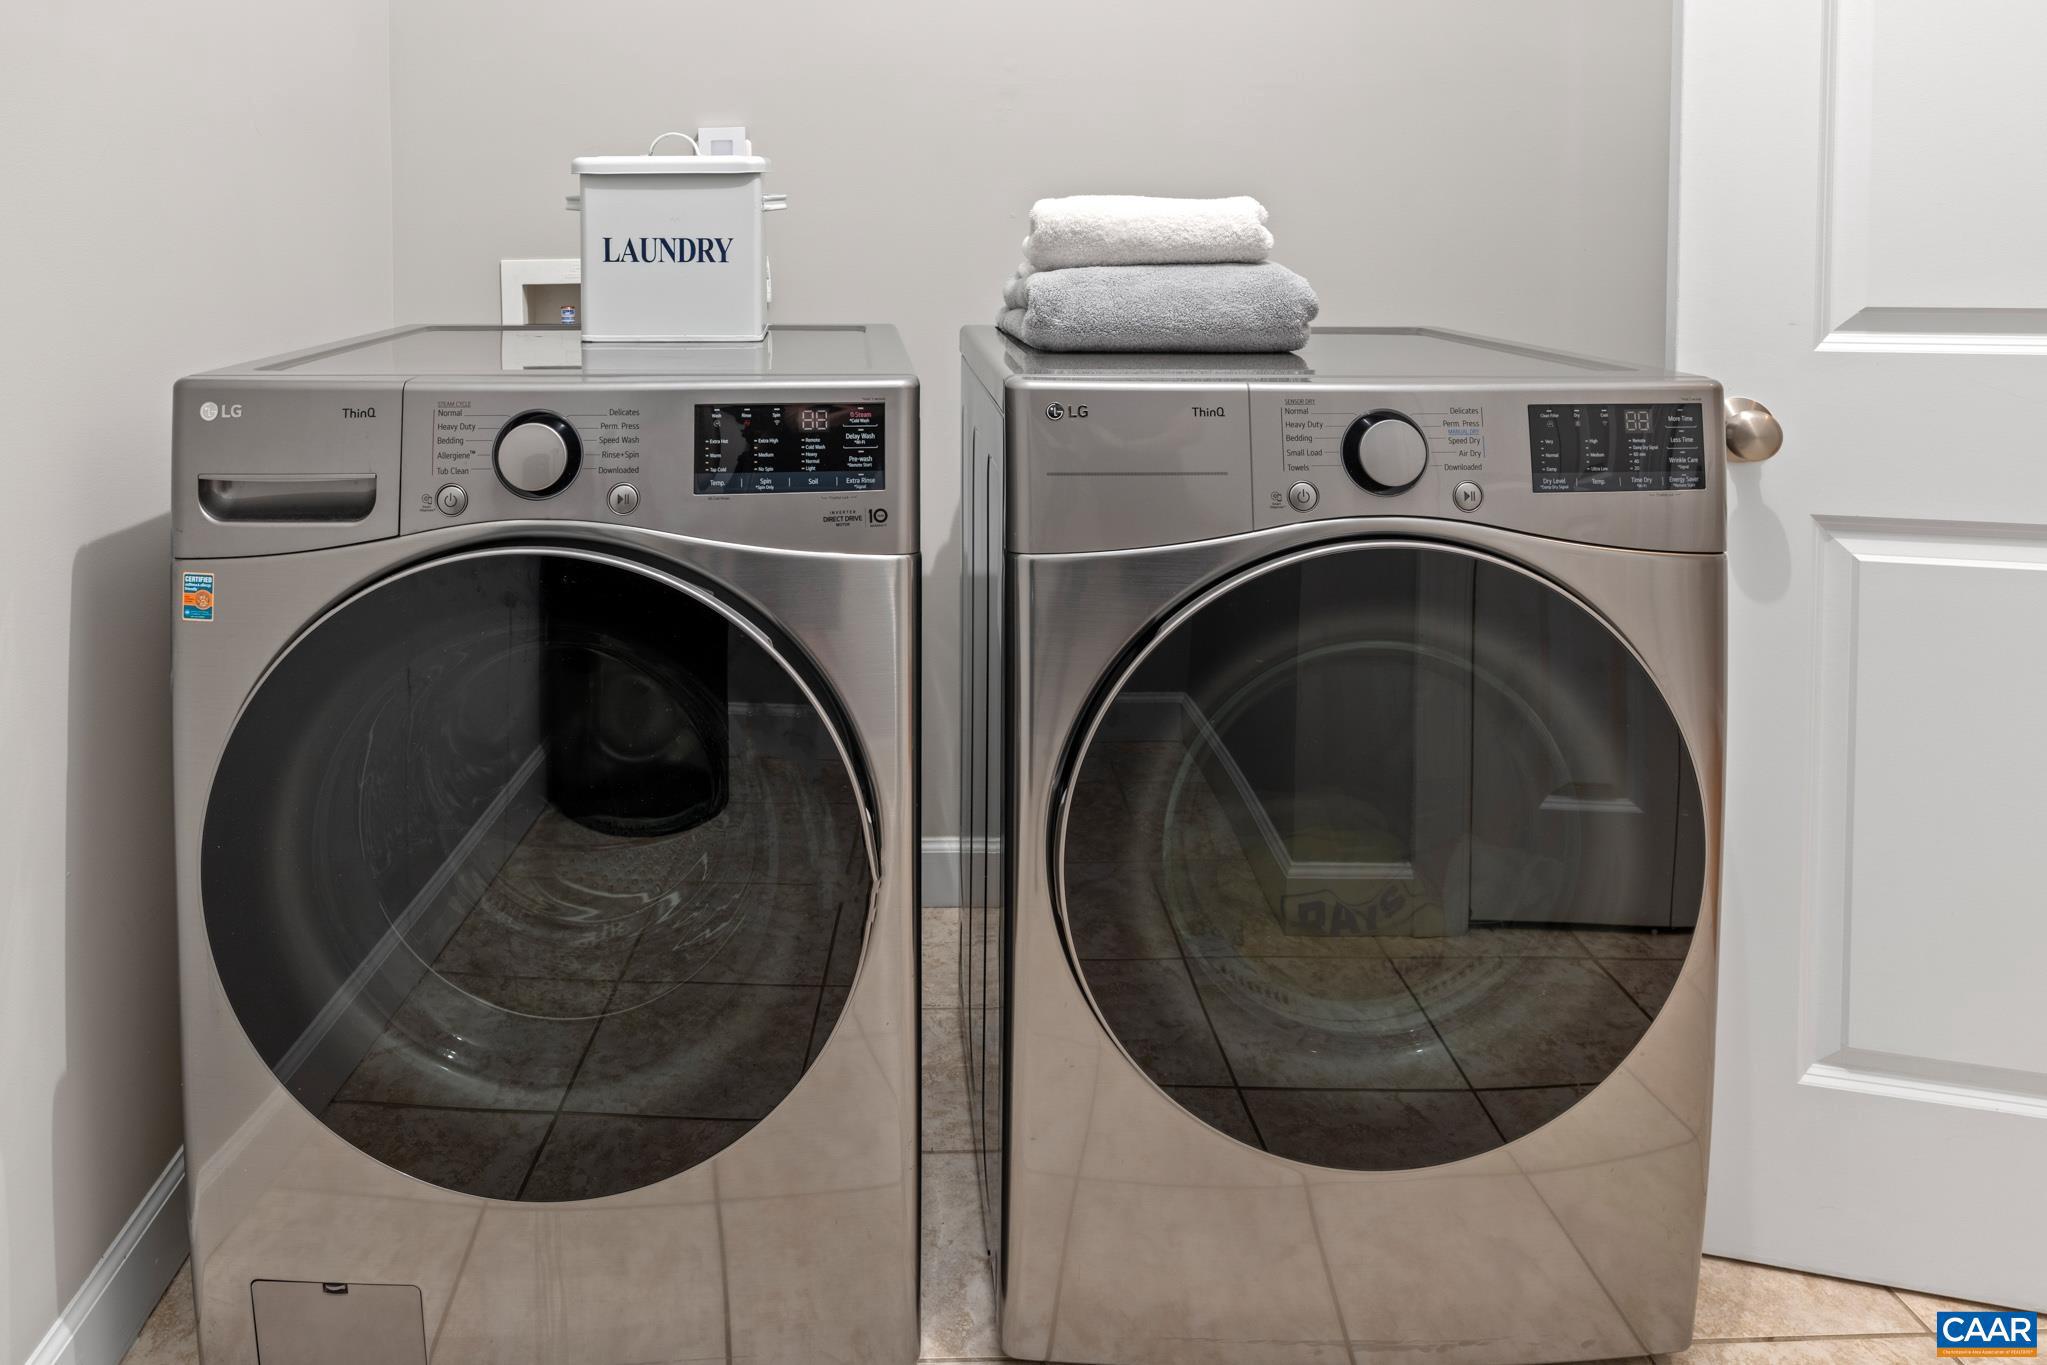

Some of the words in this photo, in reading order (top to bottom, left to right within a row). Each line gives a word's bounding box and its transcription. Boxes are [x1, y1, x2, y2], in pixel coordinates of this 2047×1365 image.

[602, 237, 734, 263] LAUNDRY
[221, 404, 242, 418] LG
[342, 407, 376, 418] ThinQ
[609, 408, 640, 416] Delicates
[1068, 405, 1089, 418] LG
[1192, 407, 1225, 418] ThinQ
[802, 410, 828, 430] 88
[1626, 411, 1650, 431] 88
[438, 423, 457, 432] Heavy
[460, 423, 476, 432] Duty
[1285, 421, 1305, 430] Heavy
[1307, 421, 1323, 430] Duty
[437, 437, 464, 446] Bedding
[599, 436, 620, 445] Speed
[1285, 435, 1313, 443] Bedding
[1448, 437, 1468, 445] Speed
[1469, 437, 1481, 445] Dry
[1470, 450, 1481, 458] Dry
[438, 467, 449, 475] Tub
[450, 467, 469, 475] Clean
[759, 478, 772, 486] Spin
[1669, 476, 1685, 484] Energy
[868, 508, 888, 523] 10
